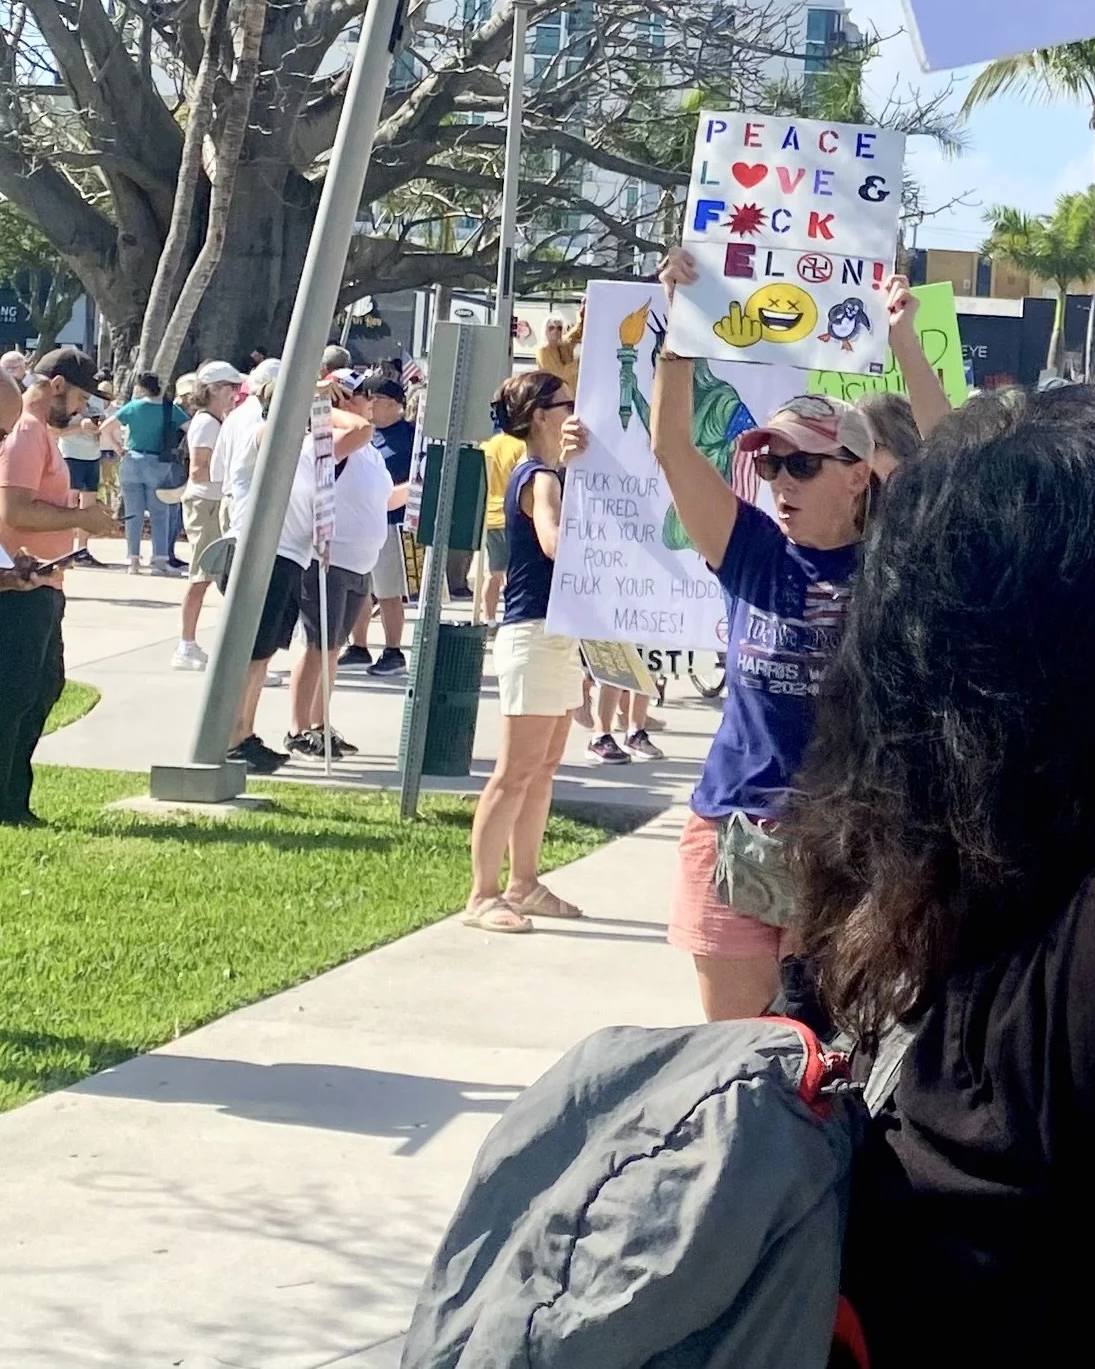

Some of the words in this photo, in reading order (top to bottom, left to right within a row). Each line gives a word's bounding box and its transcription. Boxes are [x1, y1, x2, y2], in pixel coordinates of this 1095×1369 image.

[706, 120, 876, 159] PEACE
[858, 176, 890, 202] &
[693, 199, 834, 240] FCK
[573, 469, 610, 493] FUCK
[618, 474, 661, 498] YOUR
[565, 517, 608, 542] FUCK
[617, 521, 657, 544] YOUR
[560, 572, 602, 596] FUCK
[615, 576, 656, 598] YOUR
[613, 608, 685, 634] MASSES!
[637, 647, 694, 674] ST!
[737, 653, 799, 680] HARRIS
